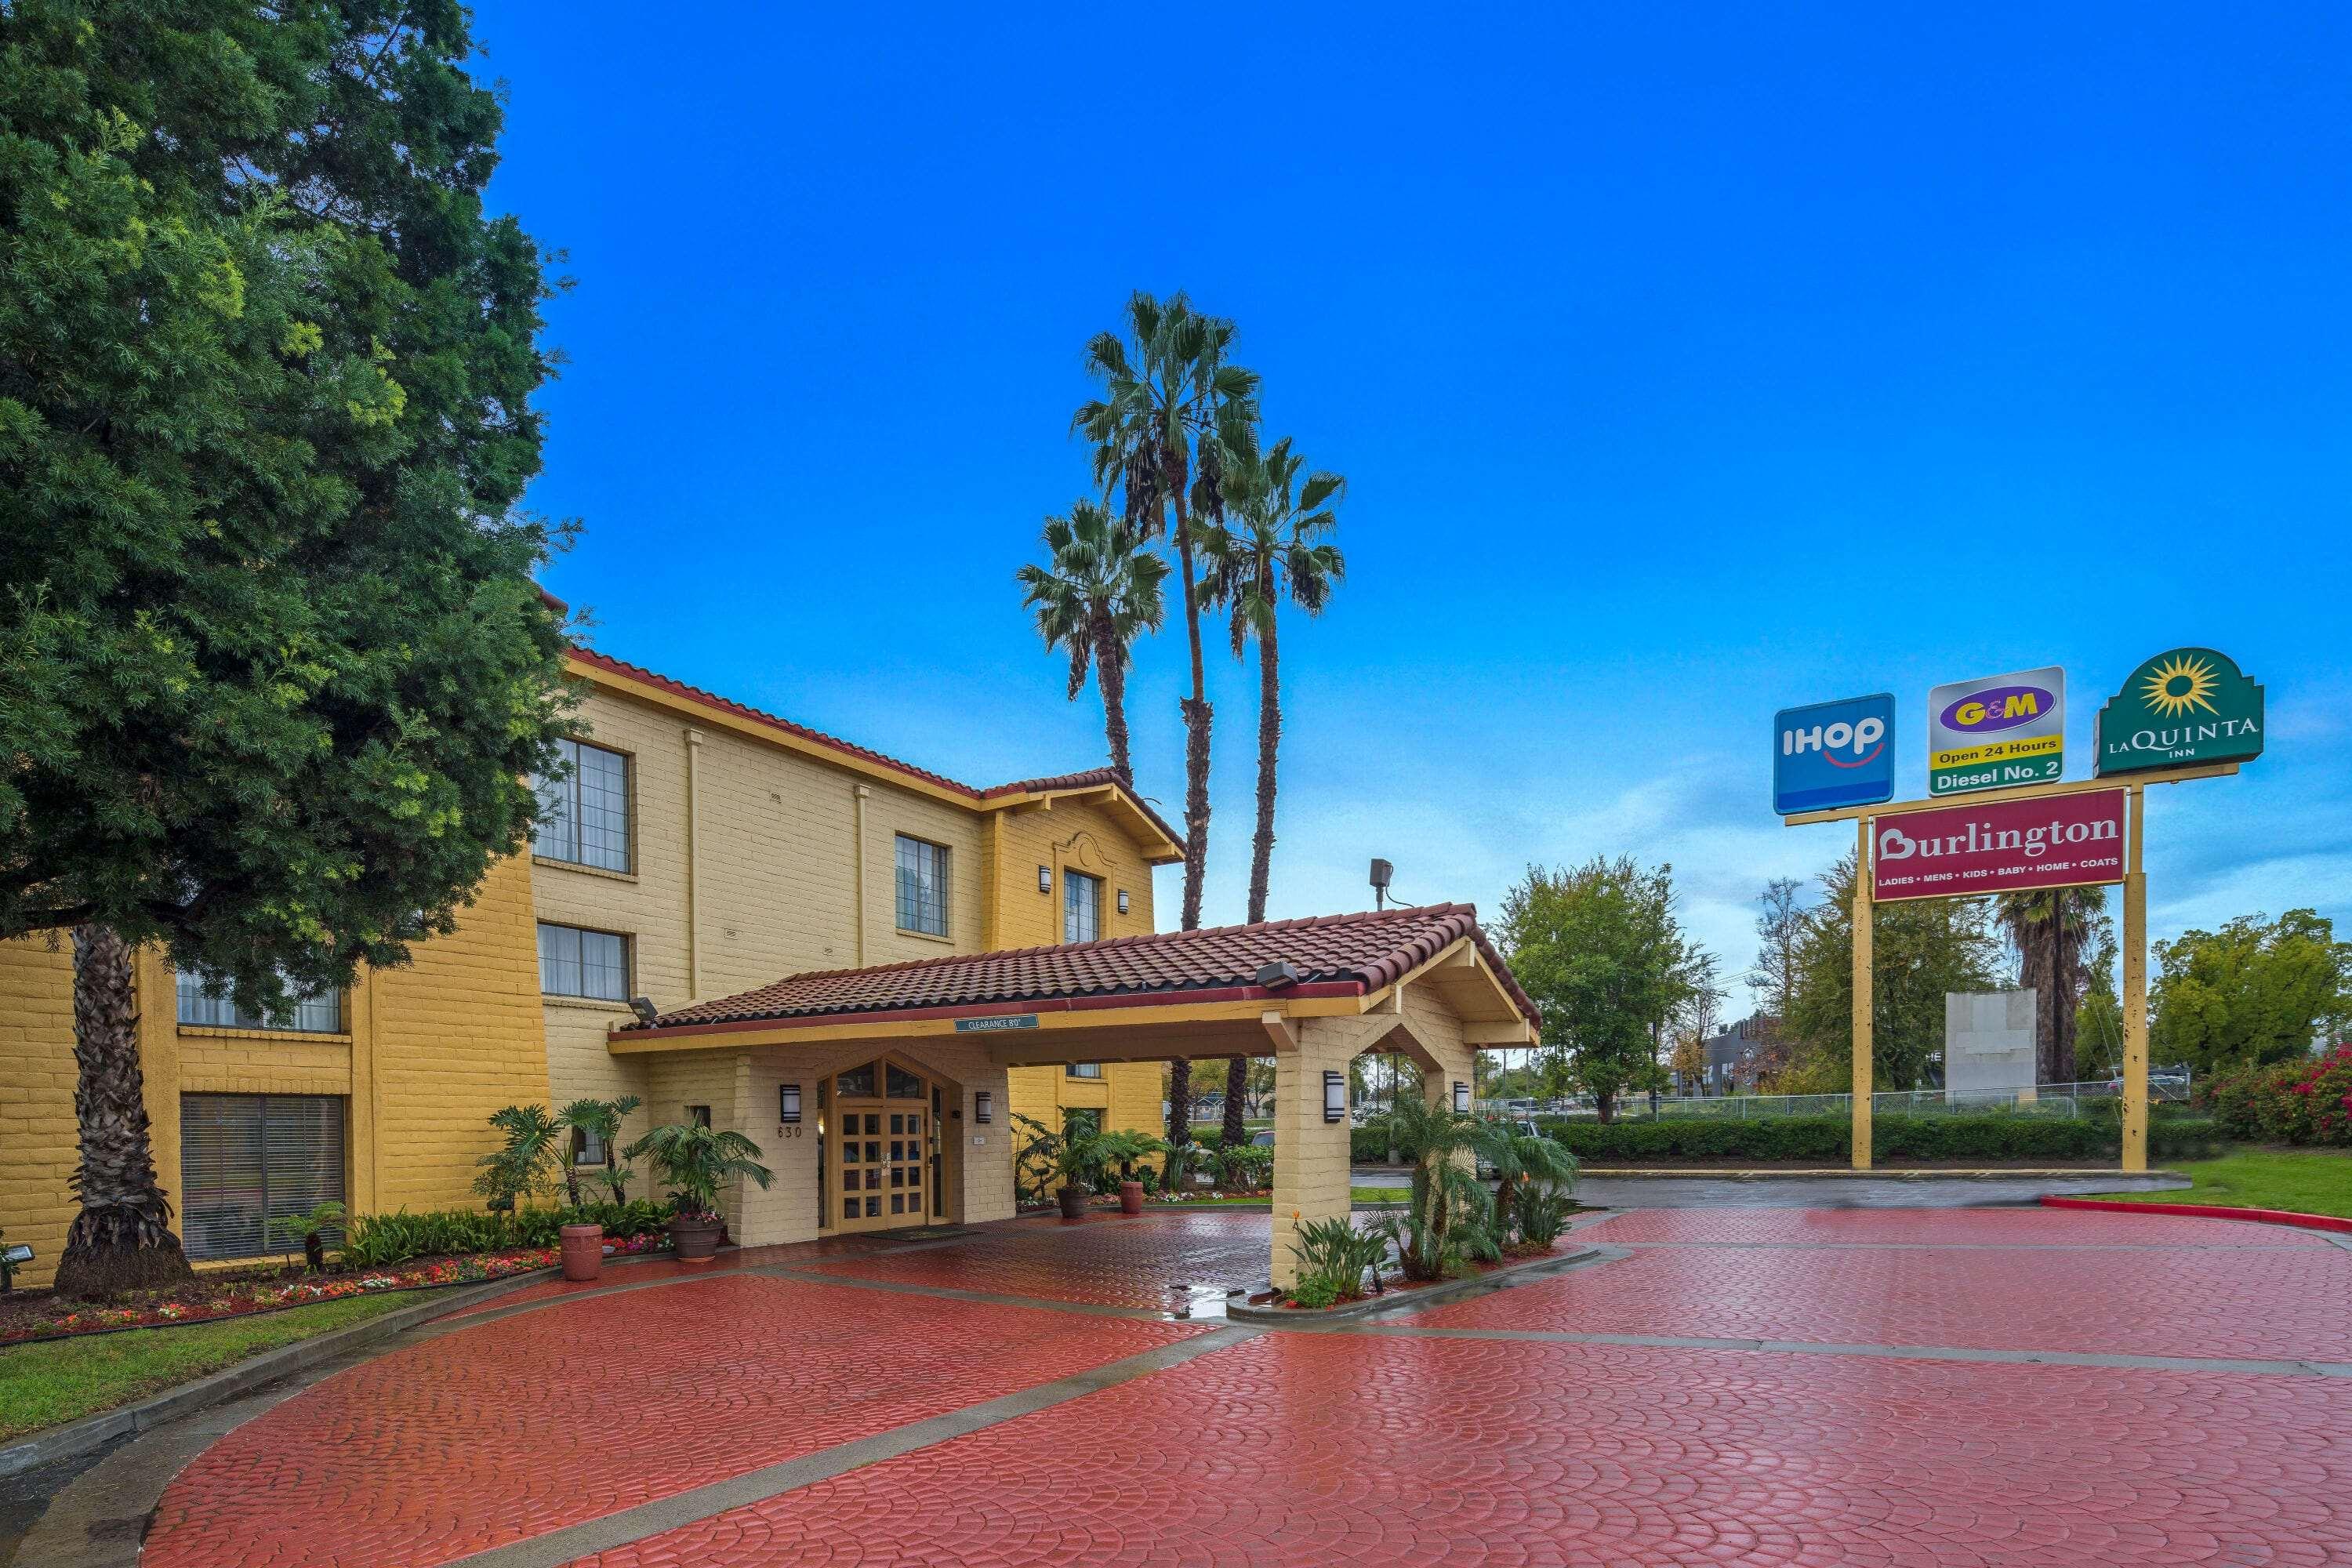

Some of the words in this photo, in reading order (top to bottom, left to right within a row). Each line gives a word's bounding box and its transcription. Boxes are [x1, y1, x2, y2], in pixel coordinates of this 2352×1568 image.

[1955, 692, 2038, 726] G&M
[1783, 717, 1885, 756] IHOP
[2109, 742, 2130, 753] LA
[2131, 717, 2259, 751] QUINTA
[1939, 751, 1979, 764] Open
[1984, 746, 2004, 757] 24
[2009, 739, 2056, 753] Hours
[2169, 748, 2195, 759] INN
[1937, 768, 1997, 789] Diesel
[2004, 765, 2039, 781] No.
[2045, 761, 2058, 775] 2
[1879, 818, 2119, 861] Burlington
[1878, 877, 1914, 887] LADIES
[1923, 873, 1953, 882] MENS
[1962, 869, 1987, 878] KIDS
[1998, 866, 2026, 876] BABY
[2036, 862, 2070, 872] HOME
[2080, 857, 2118, 868] COATS
[968, 1019, 1008, 1029] CLEARANCE
[778, 1127, 802, 1138] 630
